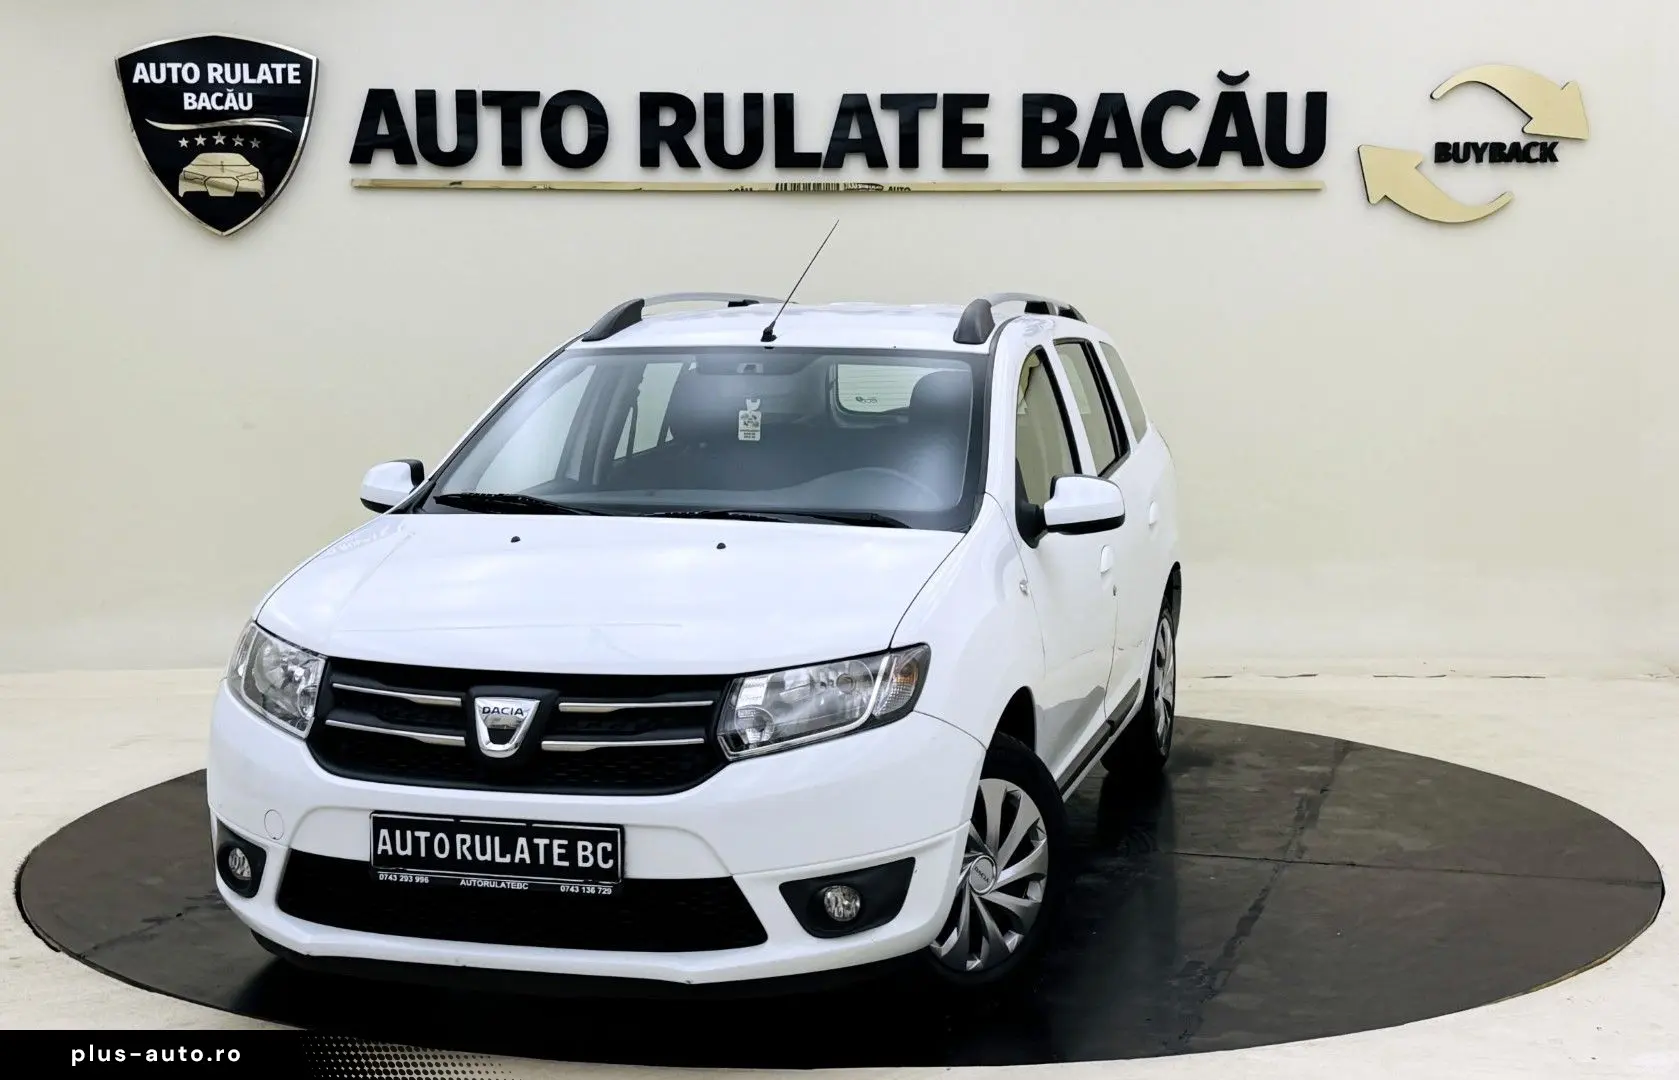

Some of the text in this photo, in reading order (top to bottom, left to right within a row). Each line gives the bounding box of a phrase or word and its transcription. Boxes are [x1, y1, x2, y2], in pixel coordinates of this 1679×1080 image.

[132, 62, 302, 84] AUTO RULATE
[183, 88, 253, 110] BACĂU
[349, 69, 1328, 169] AUTO RULATE BACĂU
[1434, 141, 1559, 164] BUYBACK
[482, 706, 524, 716] DACIA
[377, 828, 614, 869] AUTO RULATE BC
[379, 873, 398, 881] 0743
[400, 875, 413, 883] 293
[460, 879, 529, 890] AUTORULATEBC
[560, 885, 580, 893] 0743
[597, 887, 612, 895] 729
